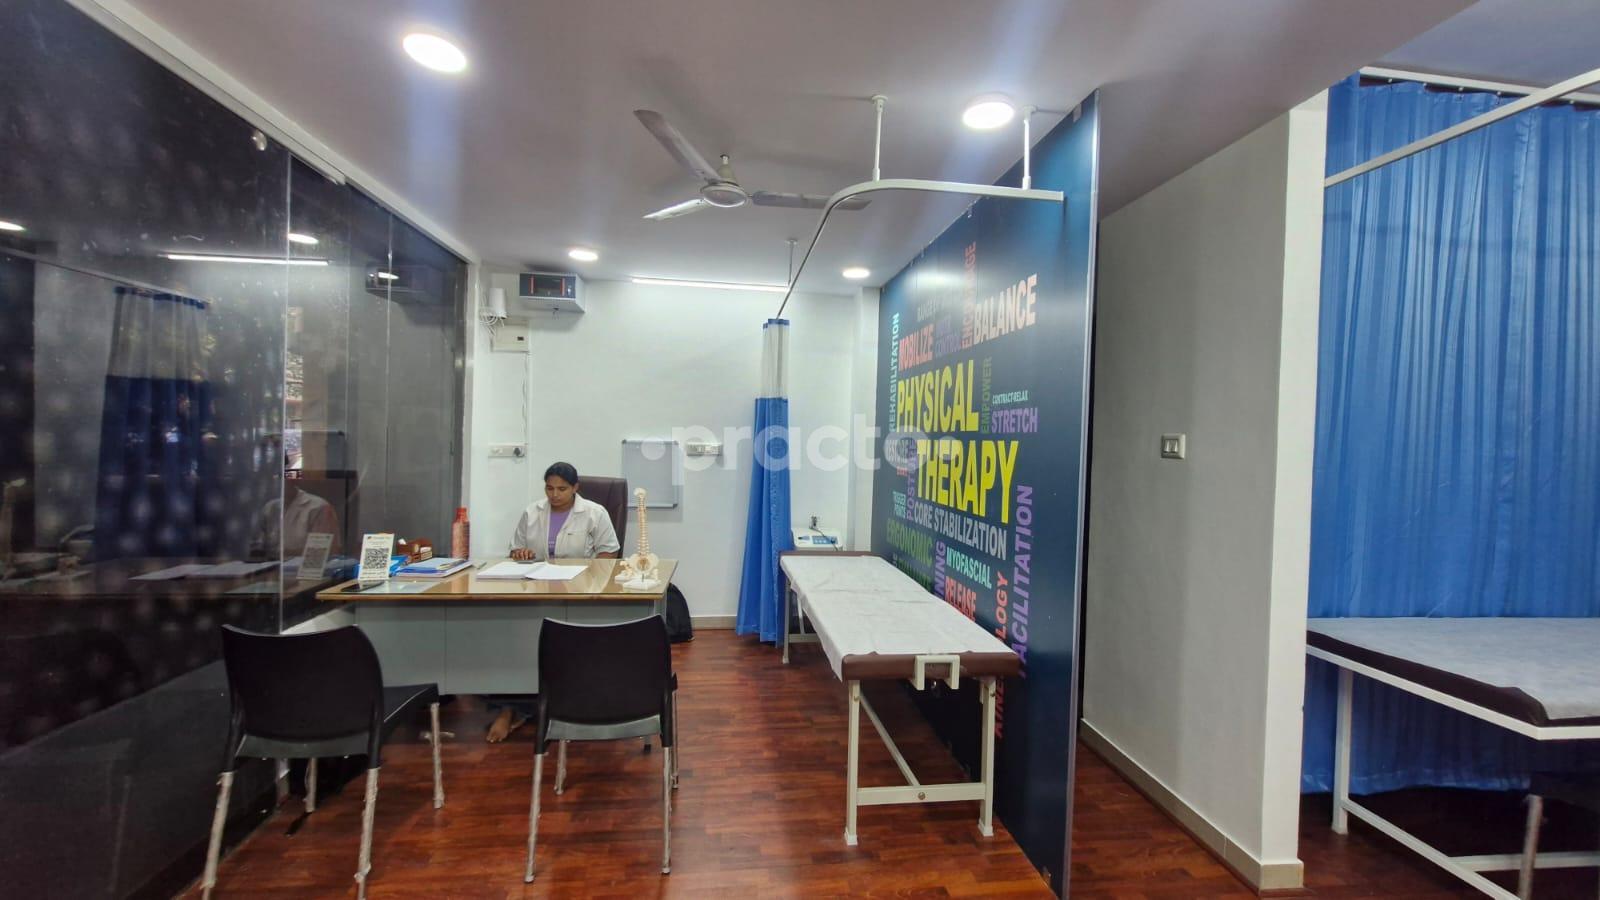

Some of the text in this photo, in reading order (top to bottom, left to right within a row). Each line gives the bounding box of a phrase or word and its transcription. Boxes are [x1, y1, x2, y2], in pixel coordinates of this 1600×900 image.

[974, 273, 1038, 345] BALANCE
[888, 312, 900, 432] REHABILITATION
[898, 324, 934, 371] MOBILIZE
[897, 359, 979, 432] PHYSICAL
[981, 356, 992, 434] EMPOWER
[991, 407, 1038, 433] STRETCH
[916, 440, 1019, 524] THERAPY
[886, 517, 933, 567] ERGONOMIC
[914, 501, 1007, 561] CORE STABILIZATION
[946, 547, 992, 590] MYOFASCIAL
[945, 576, 977, 622] RELEASE
